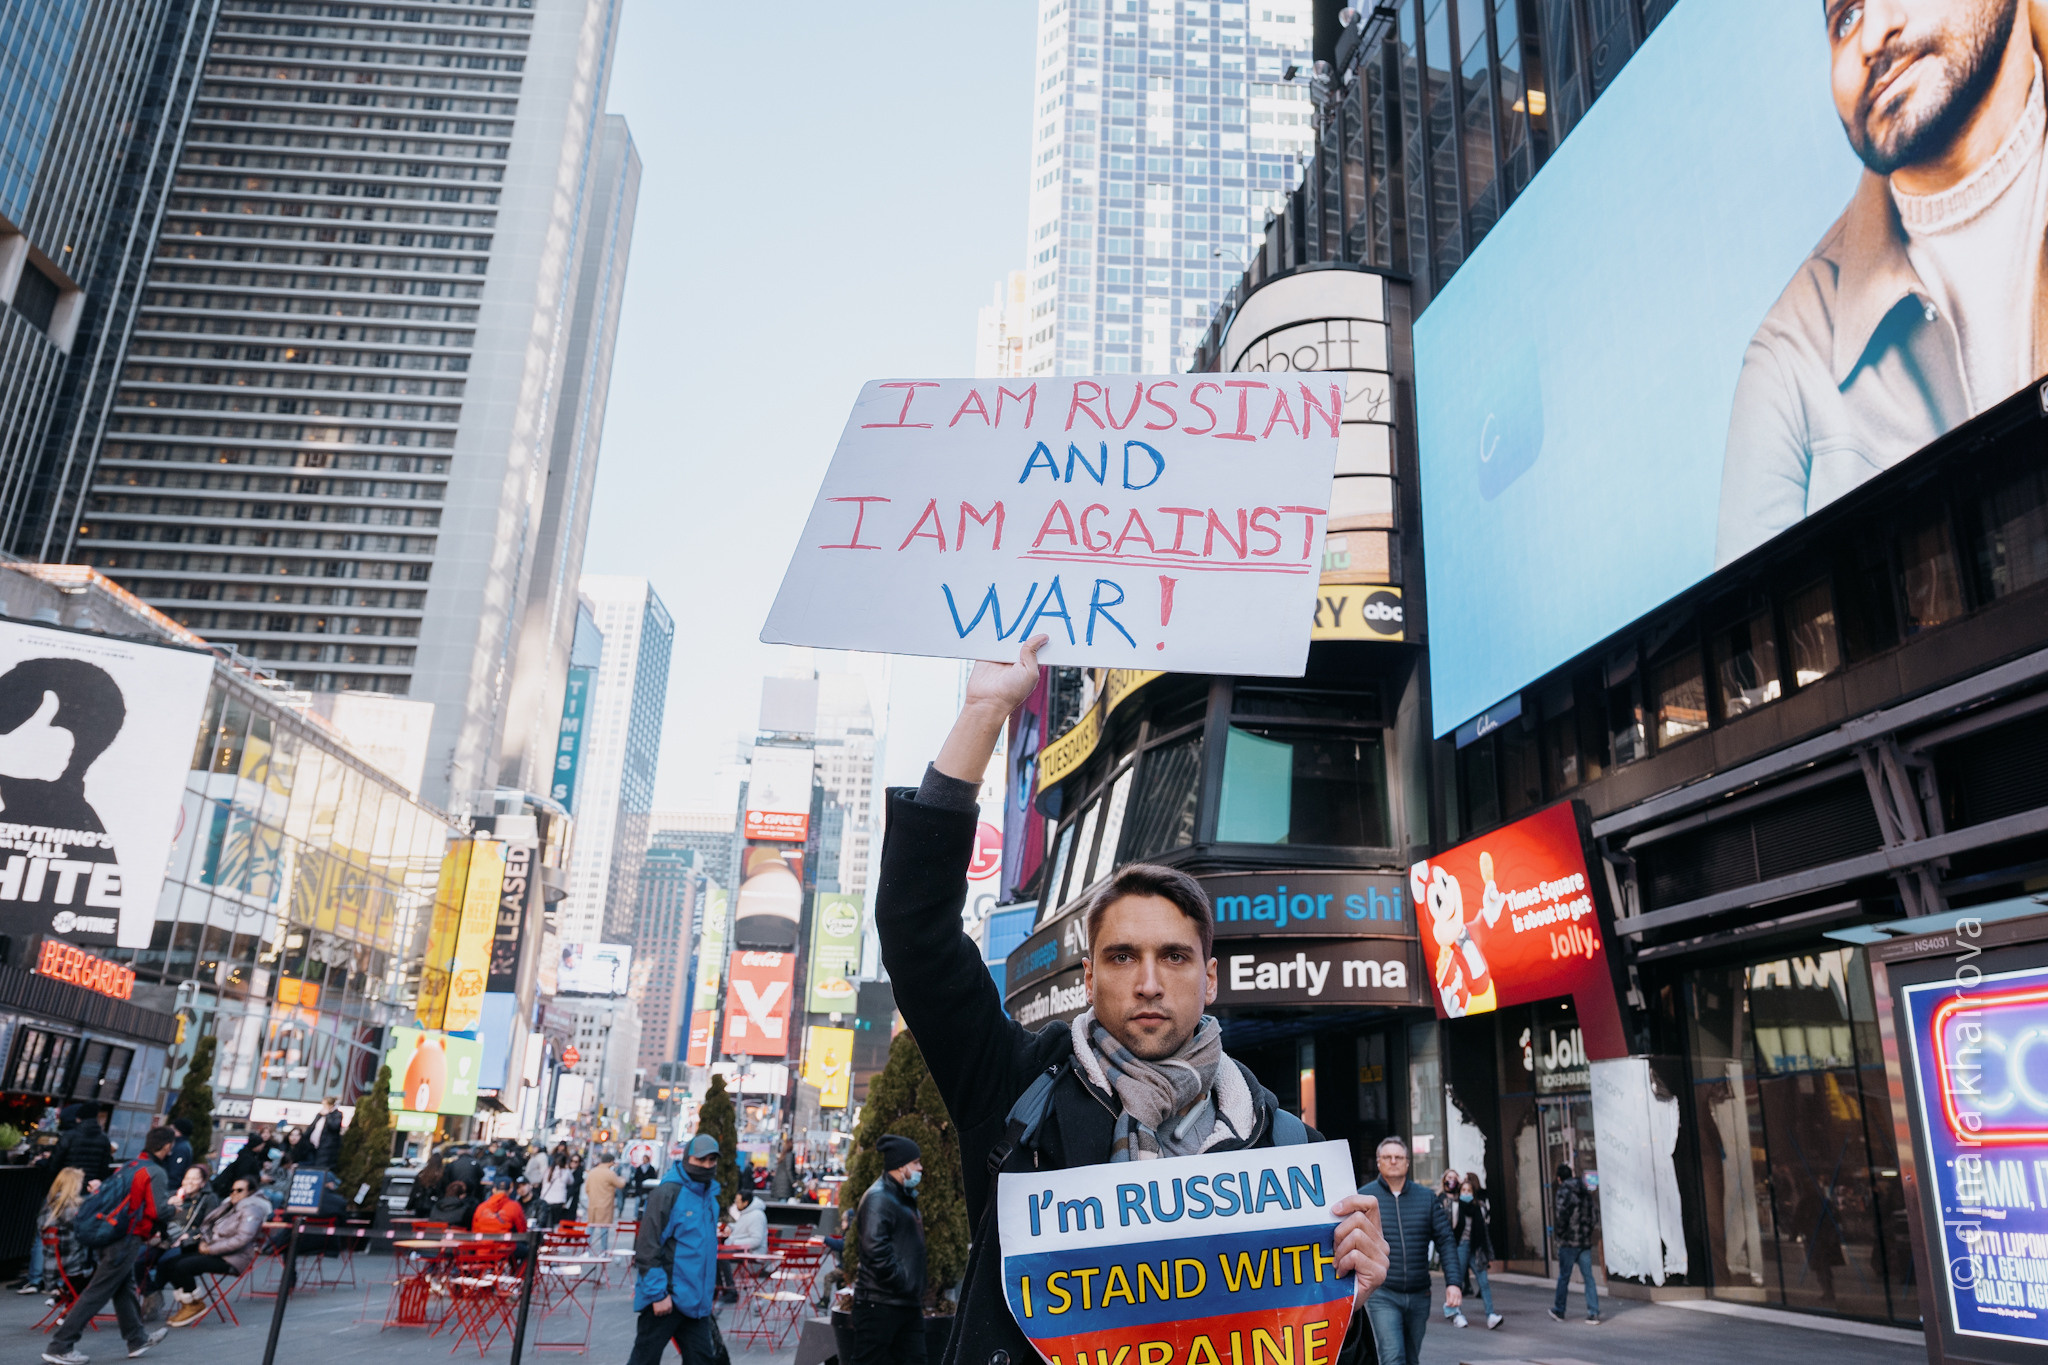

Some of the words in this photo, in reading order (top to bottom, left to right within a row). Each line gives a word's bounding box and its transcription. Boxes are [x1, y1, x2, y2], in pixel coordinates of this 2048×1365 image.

[861, 382, 940, 429] I
[949, 382, 1037, 429] AM
[1065, 380, 1342, 441] RUSSIAN
[1018, 440, 1166, 490] AND
[818, 496, 891, 550] I
[898, 497, 1005, 553] AM
[1031, 499, 1328, 560] AGAINST
[1363, 601, 1404, 623] abc
[557, 680, 584, 771] TIMES
[26, 841, 69, 859] ALL
[489, 845, 531, 975] RLEASED
[1216, 886, 1334, 928] major
[1344, 886, 1402, 921] shi
[1505, 889, 1541, 912] Times
[1538, 872, 1585, 902] Square
[1511, 913, 1525, 934] is
[1523, 905, 1557, 931] about
[1554, 903, 1570, 921] to
[1569, 894, 1592, 922] get
[1549, 923, 1600, 960] Jolly.
[1914, 936, 1950, 952] NS4031
[41, 940, 84, 985] BEER
[79, 954, 136, 1000] GARDEN
[1229, 953, 1331, 997] Early
[1342, 960, 1407, 988] ma
[1028, 1189, 1105, 1237] I’m
[1116, 1163, 1326, 1227] RUSSIAN
[2003, 1232, 2048, 1259] LUPON
[1020, 1275, 1034, 1319] I
[1046, 1258, 1208, 1315] STAND
[1218, 1243, 1345, 1293] WITH
[1974, 1278, 2026, 1307] GOLDEN
[1051, 1319, 1330, 1365] RAINE
